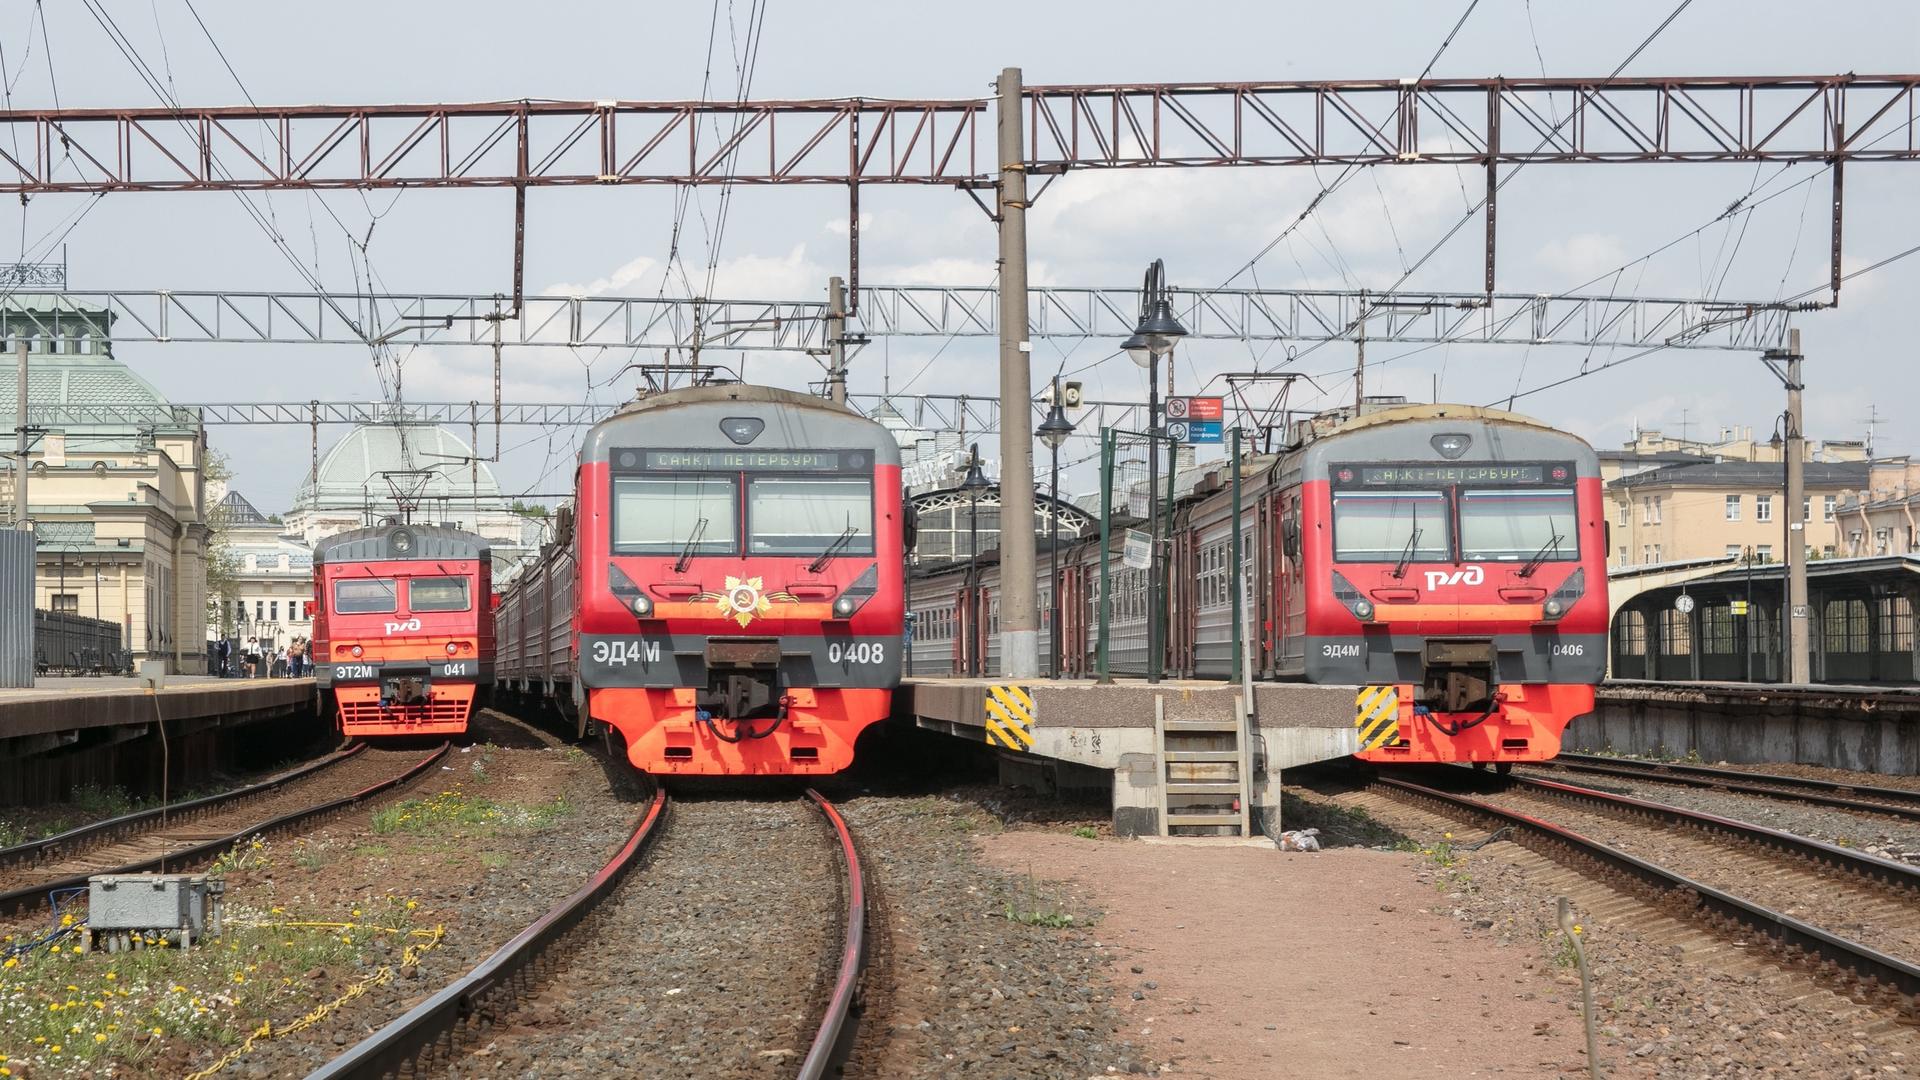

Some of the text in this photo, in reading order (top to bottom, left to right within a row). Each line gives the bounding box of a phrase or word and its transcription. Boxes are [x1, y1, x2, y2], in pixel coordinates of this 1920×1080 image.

[592, 641, 660, 666] ЭД4М
[828, 643, 884, 664] 0408
[1322, 645, 1360, 658] ЭД4М
[1553, 644, 1583, 656] 0406
[336, 666, 372, 678] ЭТ2М
[444, 663, 465, 676] 041
